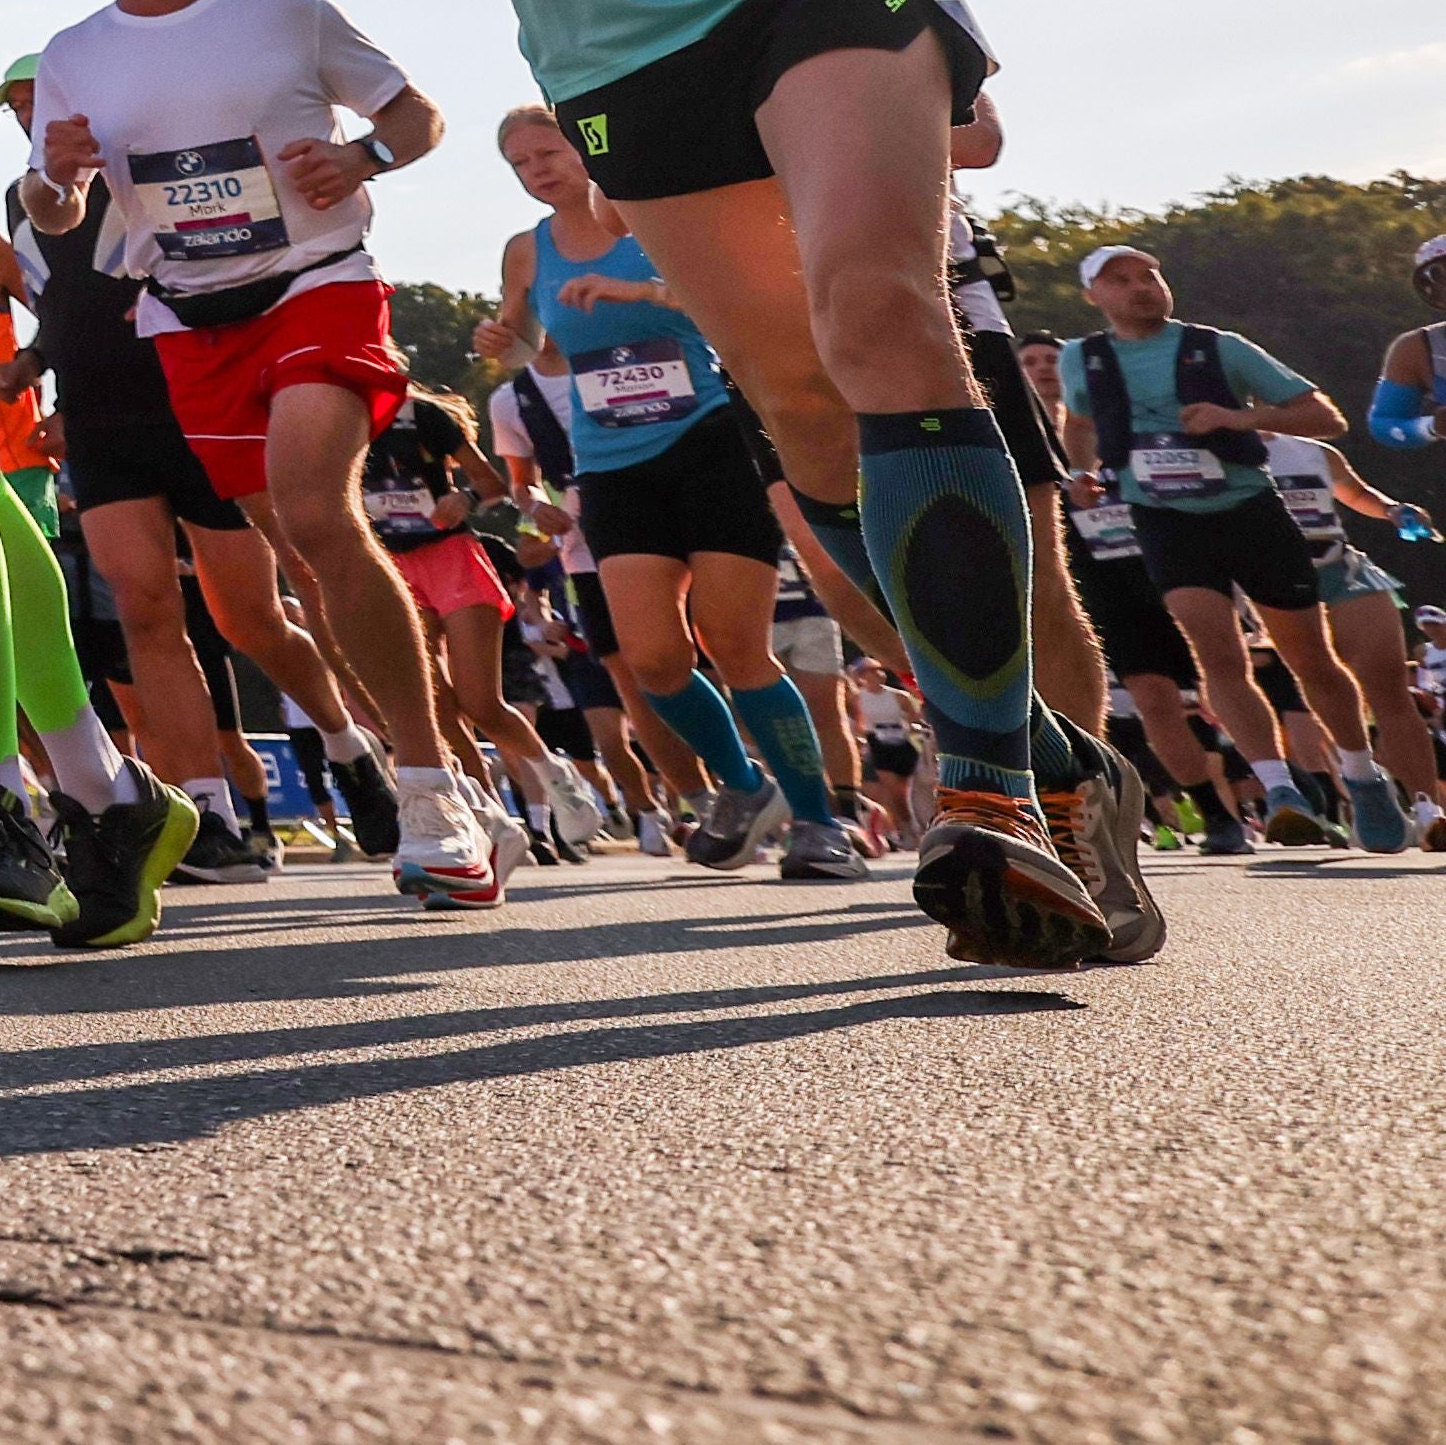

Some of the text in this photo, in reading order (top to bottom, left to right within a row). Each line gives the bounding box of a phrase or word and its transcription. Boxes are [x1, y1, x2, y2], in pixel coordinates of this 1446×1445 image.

[164, 177, 242, 205] 22310
[182, 227, 252, 247] zalando
[597, 365, 665, 387] 72430
